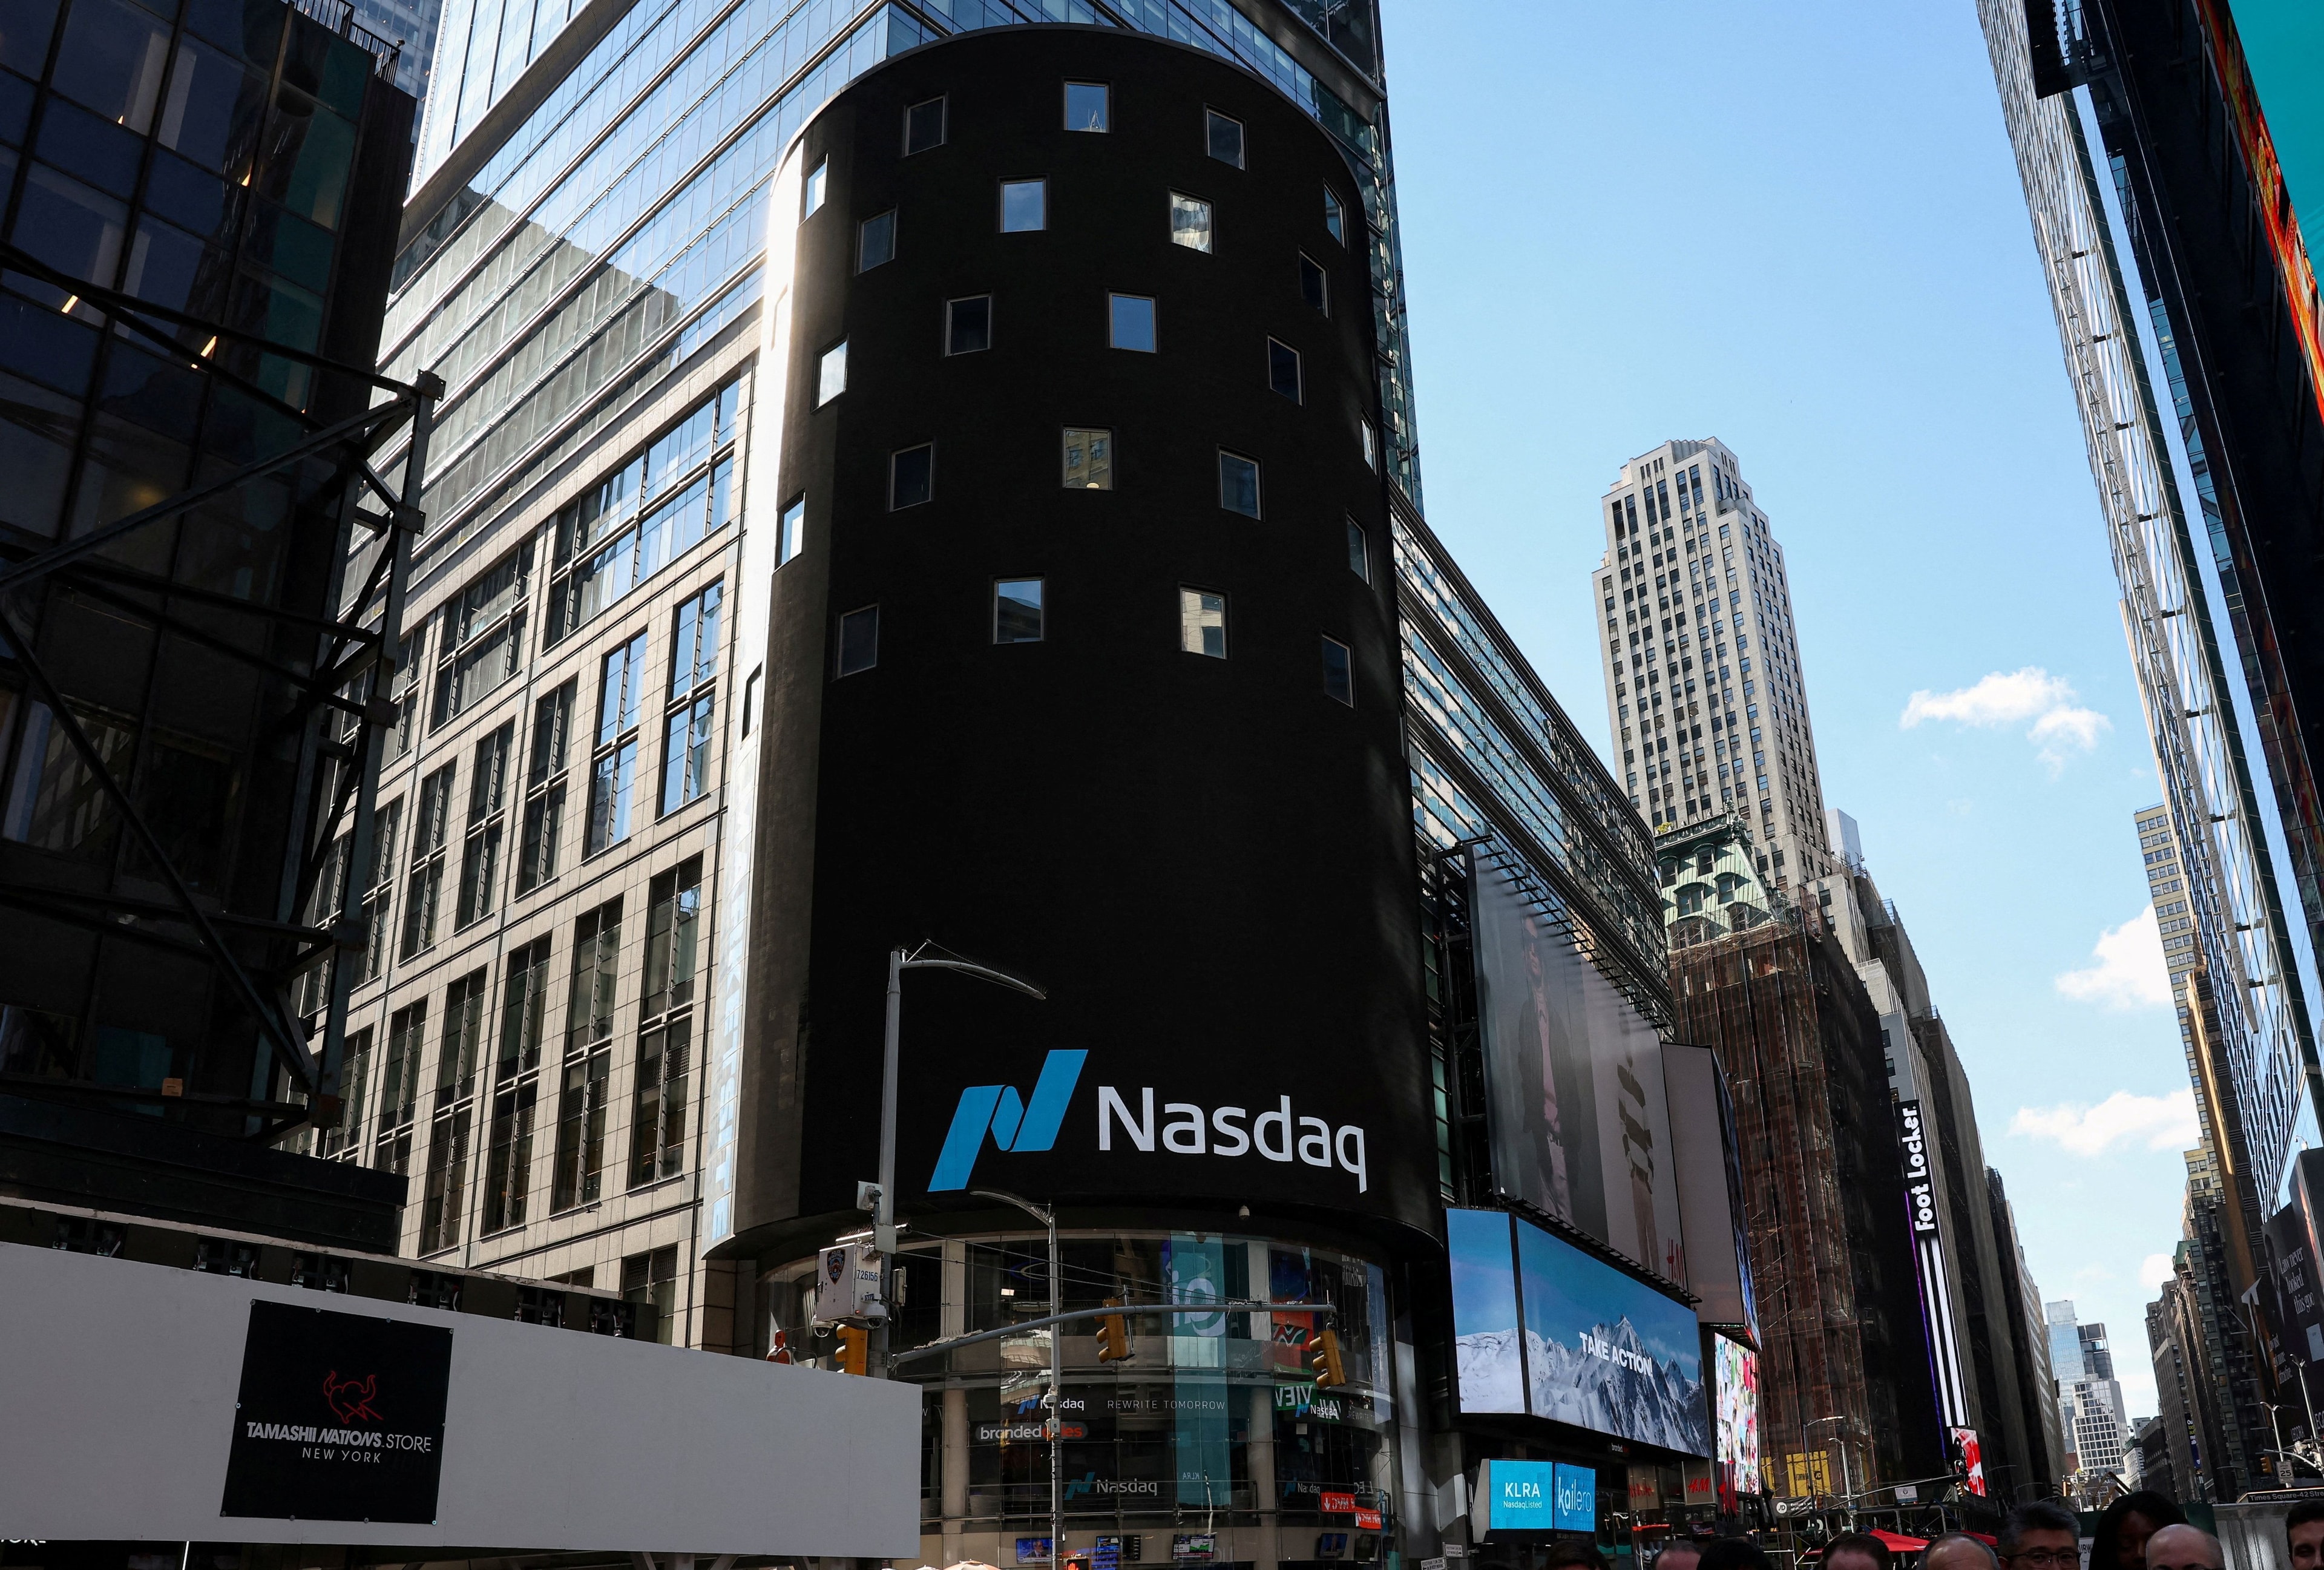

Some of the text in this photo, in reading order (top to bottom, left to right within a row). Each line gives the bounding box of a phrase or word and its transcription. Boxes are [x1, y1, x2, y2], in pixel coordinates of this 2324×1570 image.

[1097, 1085, 1368, 1194] Nasdaq
[1911, 1183, 1935, 1231] Foot
[857, 1270, 878, 1282] 726156
[2285, 1267, 2305, 1294] looked
[2294, 1294, 2305, 1315] this
[1579, 1332, 1653, 1378] TAKE ACTION!
[1107, 1400, 1225, 1410] REWRITE TOMORROW
[1310, 1404, 1338, 1419] Nasdaq
[247, 1422, 432, 1453] TAMASHII NATIONS STORE
[302, 1447, 381, 1463] NEW YORK
[1097, 1478, 1157, 1496] Nasdaq
[1505, 1482, 1541, 1498] KLRA
[1688, 1477, 1710, 1494] H&M
[1557, 1476, 1592, 1517] kailera
